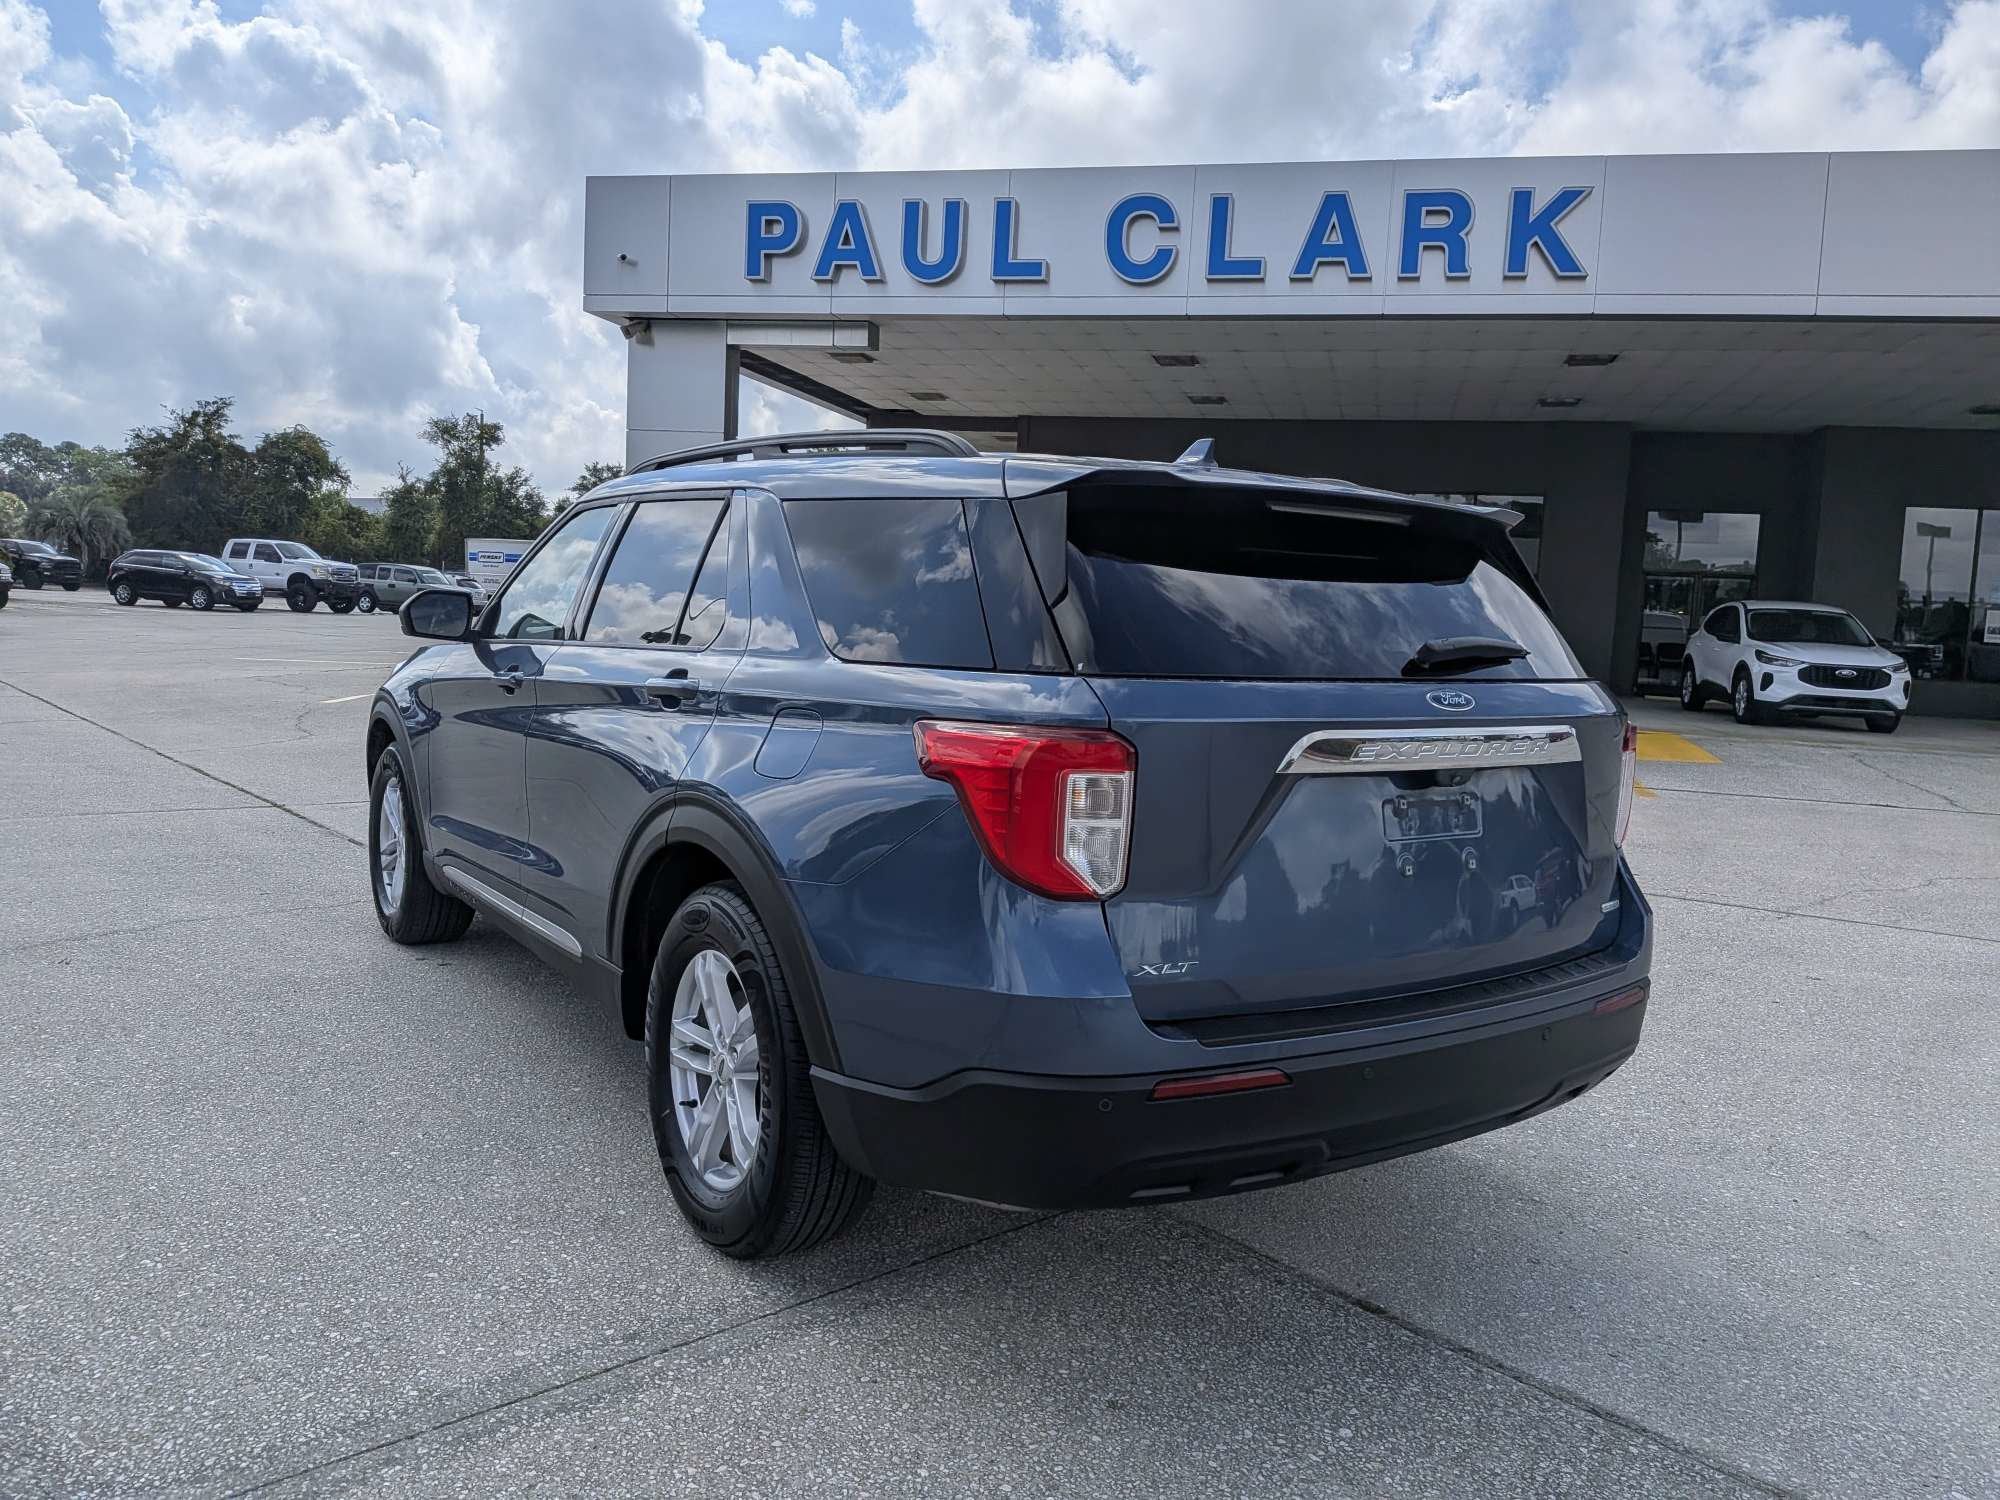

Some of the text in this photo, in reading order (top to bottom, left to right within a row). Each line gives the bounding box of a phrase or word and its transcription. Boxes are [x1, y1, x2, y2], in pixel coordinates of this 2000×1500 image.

[744, 186, 1595, 285] PAUL CLARK
[1439, 690, 1467, 705] Ford
[1349, 740, 1551, 761] EXPLORER
[1133, 961, 1199, 977] XLT
